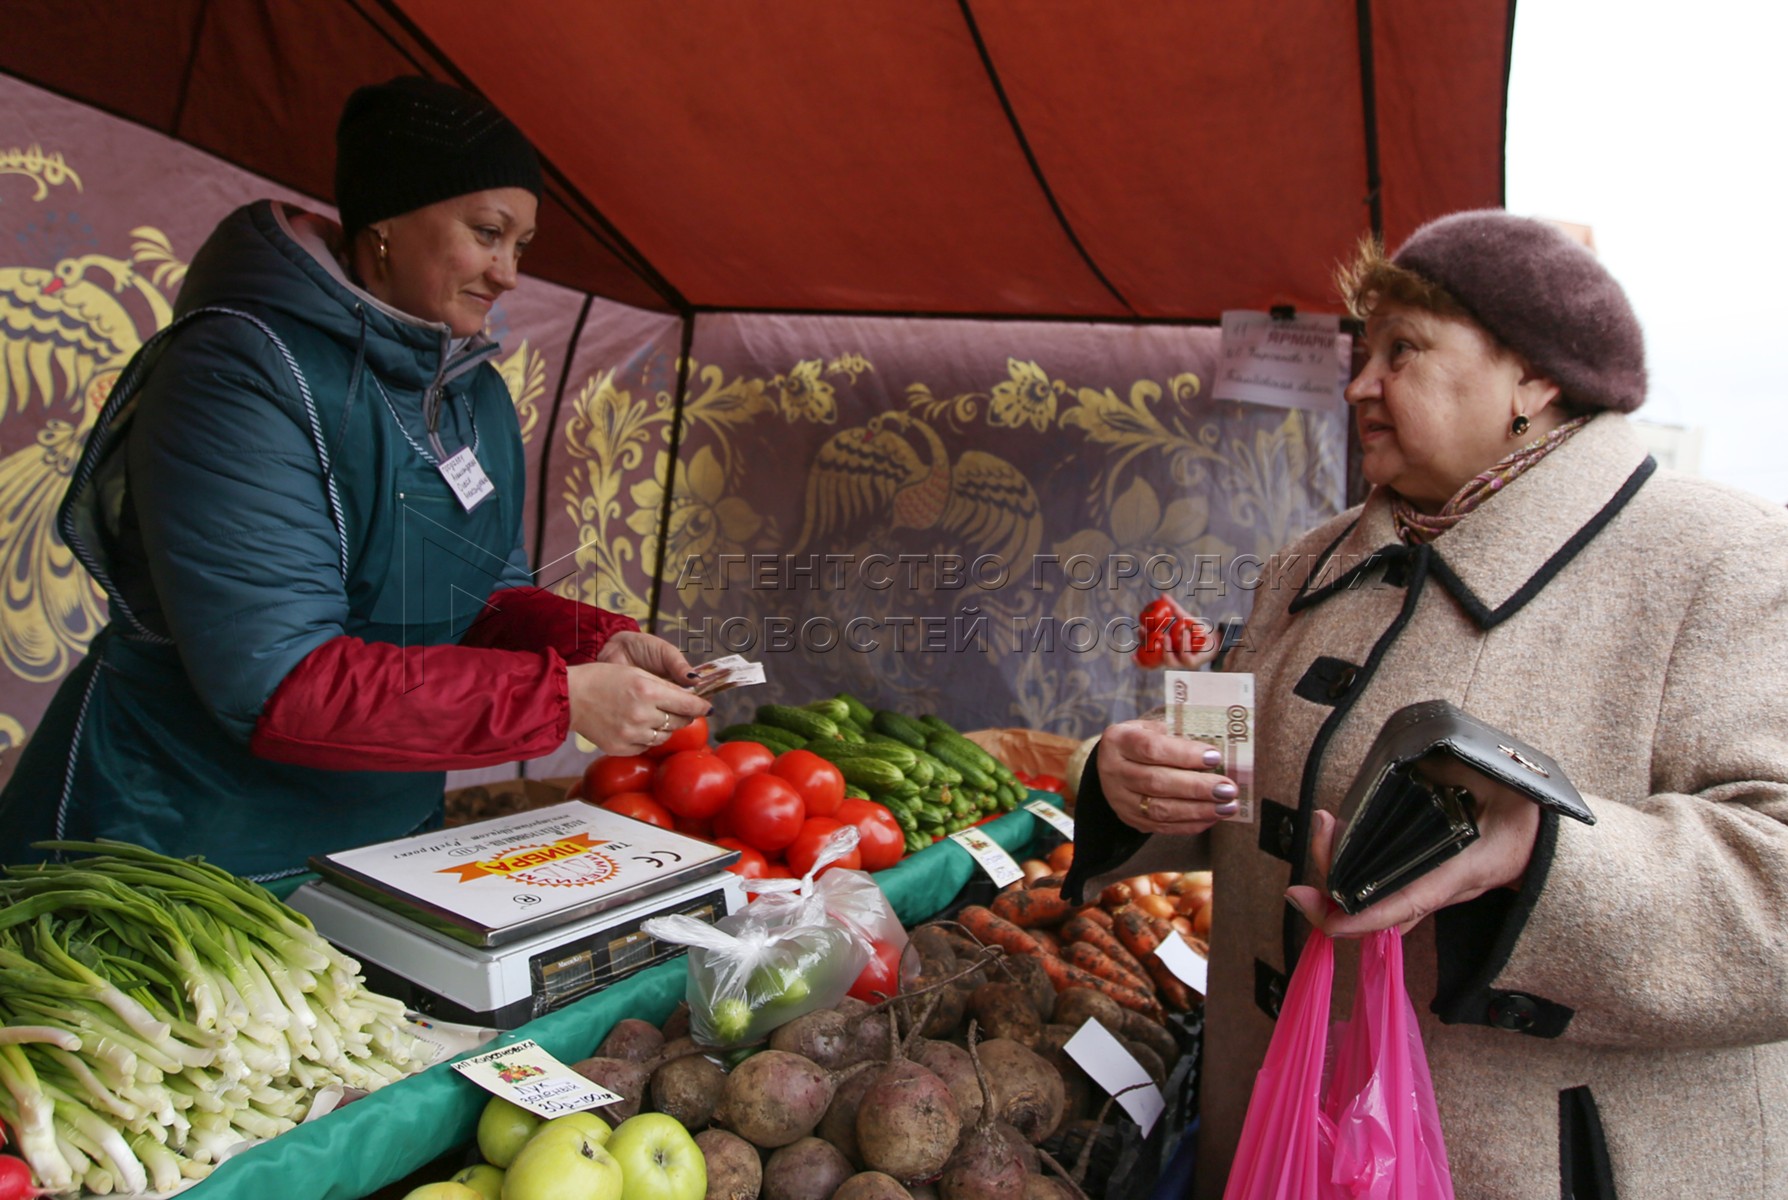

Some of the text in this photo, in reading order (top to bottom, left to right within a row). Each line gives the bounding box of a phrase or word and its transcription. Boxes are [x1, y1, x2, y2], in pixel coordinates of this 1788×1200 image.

[1174, 680, 1188, 703] 100
[1227, 704, 1248, 744] 100
[485, 844, 581, 872] ЛИБРА
[454, 1060, 471, 1070] ИП
[513, 1082, 548, 1095] Лук
